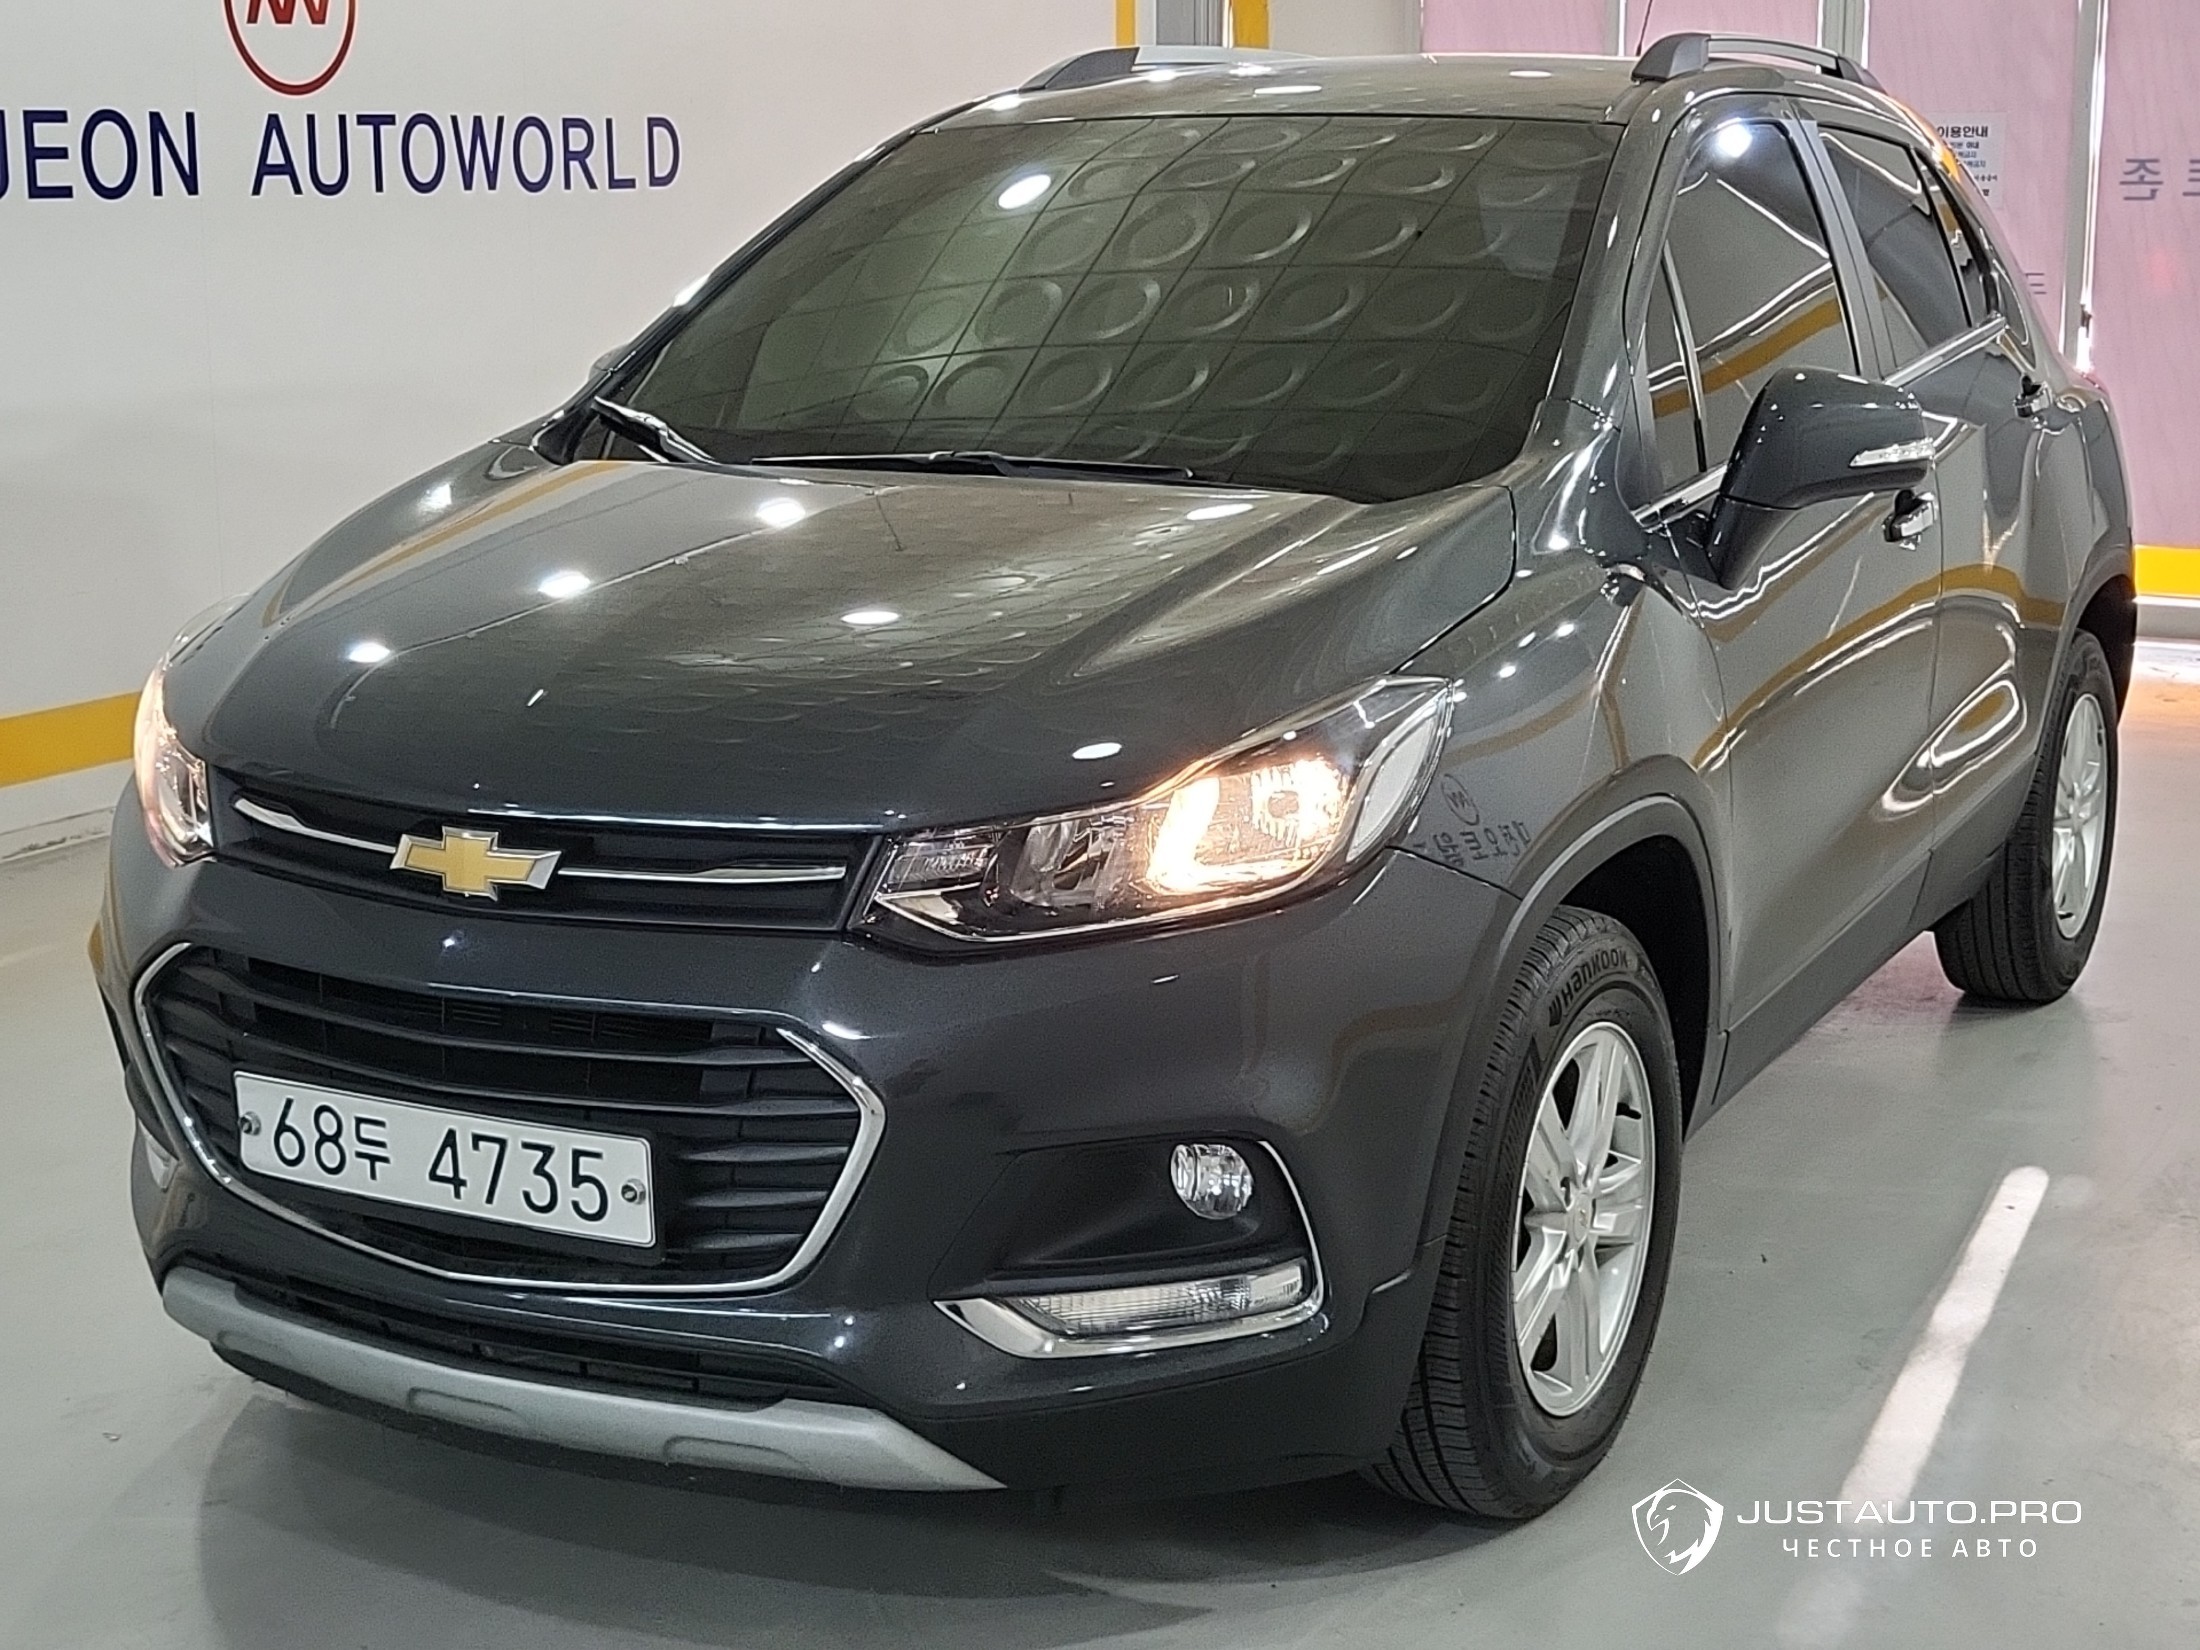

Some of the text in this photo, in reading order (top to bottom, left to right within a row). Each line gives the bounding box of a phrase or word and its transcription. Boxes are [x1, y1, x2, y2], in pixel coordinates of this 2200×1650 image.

[251, 113, 680, 196] AUTOWORLD
[1937, 126, 1988, 138] 이용안내
[274, 1098, 608, 1222] 68두 4735
